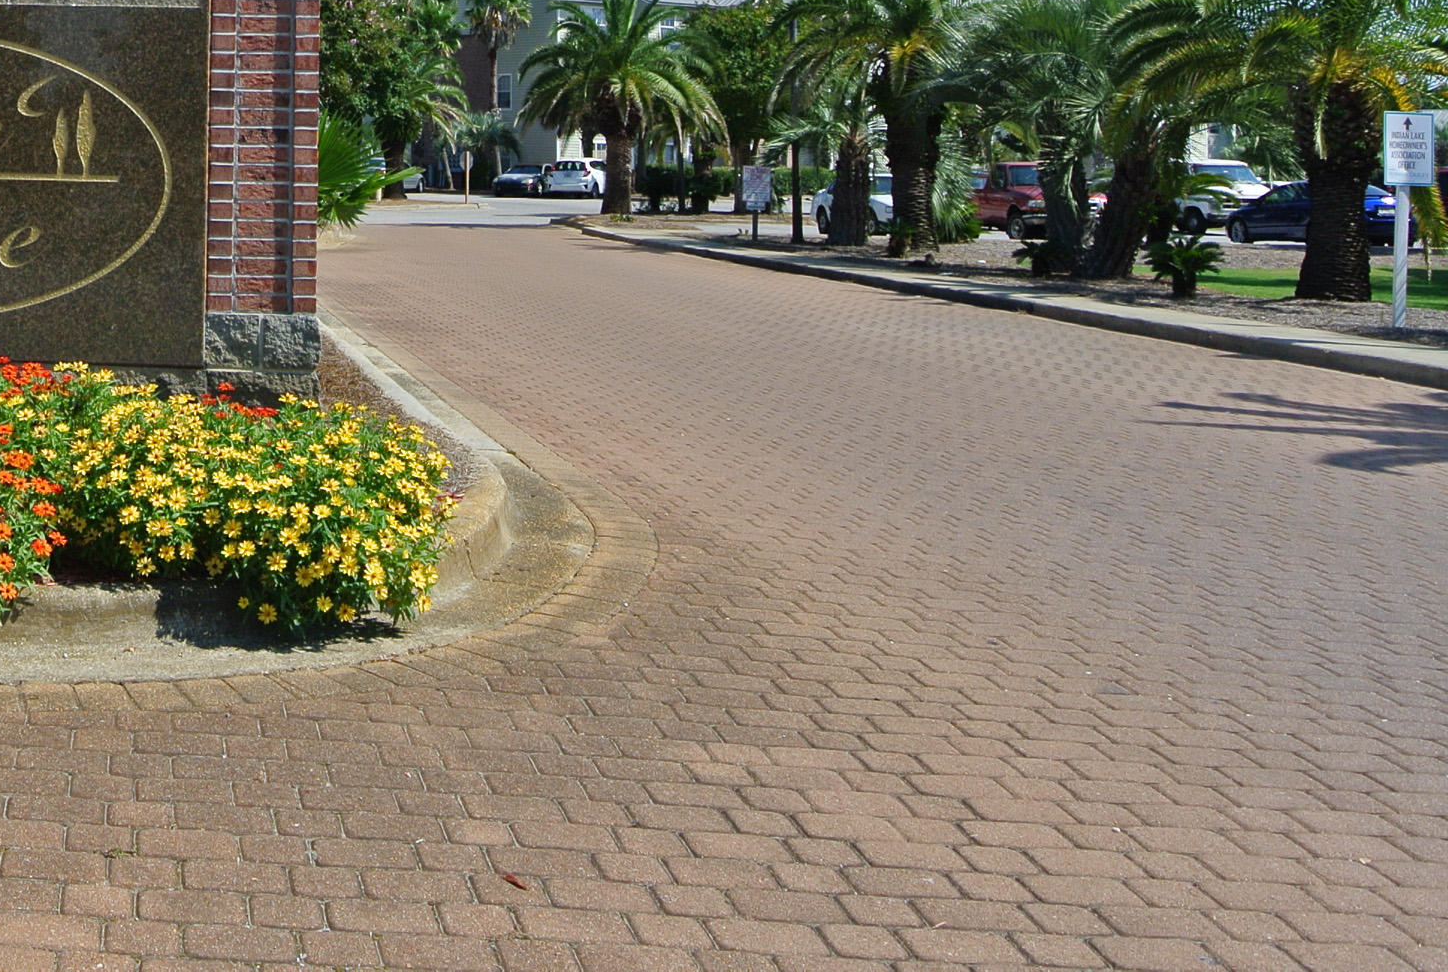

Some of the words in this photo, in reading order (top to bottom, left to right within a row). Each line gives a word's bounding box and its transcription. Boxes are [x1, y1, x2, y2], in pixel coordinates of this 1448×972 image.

[1410, 131, 1425, 139] LAKE
[1391, 150, 1426, 160] ASSOCIATION
[1398, 160, 1416, 169] OFFICE
